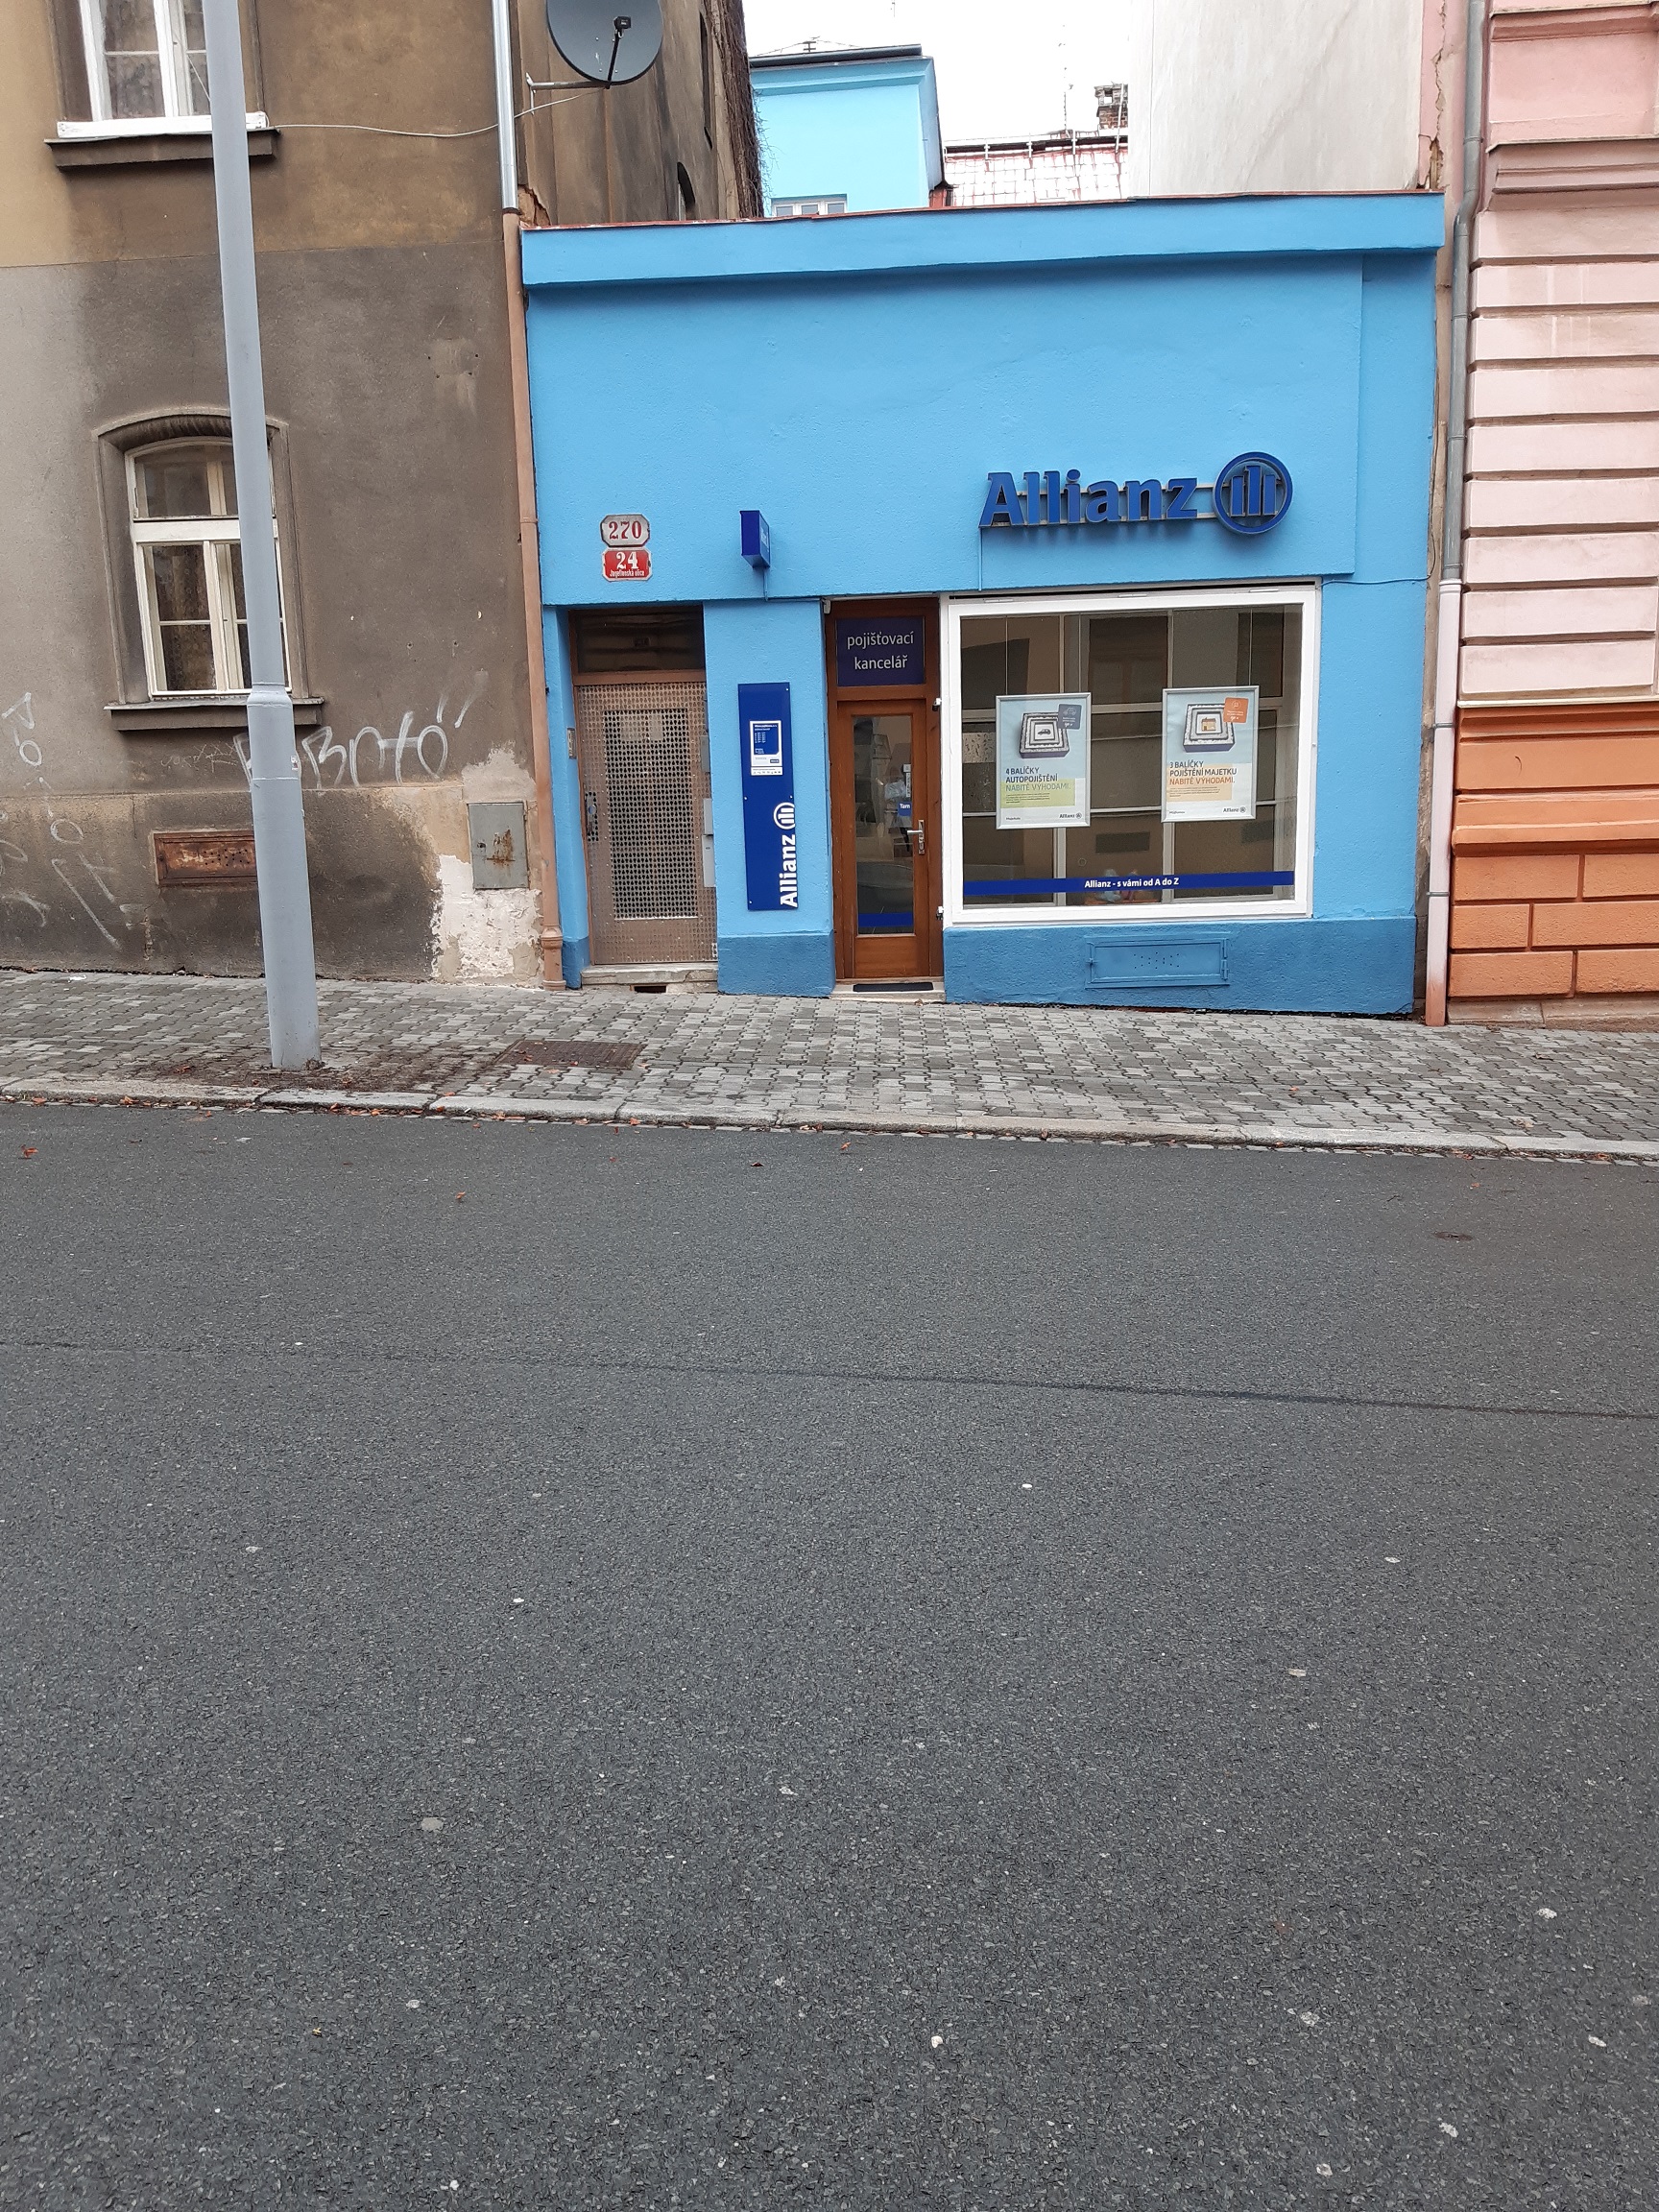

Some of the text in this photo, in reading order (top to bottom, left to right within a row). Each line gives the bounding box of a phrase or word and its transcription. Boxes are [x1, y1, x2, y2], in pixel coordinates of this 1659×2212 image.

[978, 469, 1198, 527] Allianz
[608, 520, 642, 540] 270
[615, 551, 639, 569] 24
[847, 631, 915, 650] pojišťovací
[854, 655, 908, 670] kancelář
[1174, 759, 1204, 769] BALÍČKY
[1011, 766, 1040, 776] BALÍČKY
[1169, 768, 1238, 778] POJIŠTĚNÍ MAJETKU
[1005, 773, 1058, 783] AUTOPOJIŠTĚNÍ
[1169, 776, 1236, 785] NABITÉ VÝHODAMI.
[1005, 782, 1071, 792] NABITÉ VÝHODAMI.
[779, 833, 798, 908] Allianz
[1084, 879, 1111, 888] Allianz
[1122, 878, 1142, 887] vámi
[1162, 878, 1172, 886] do
